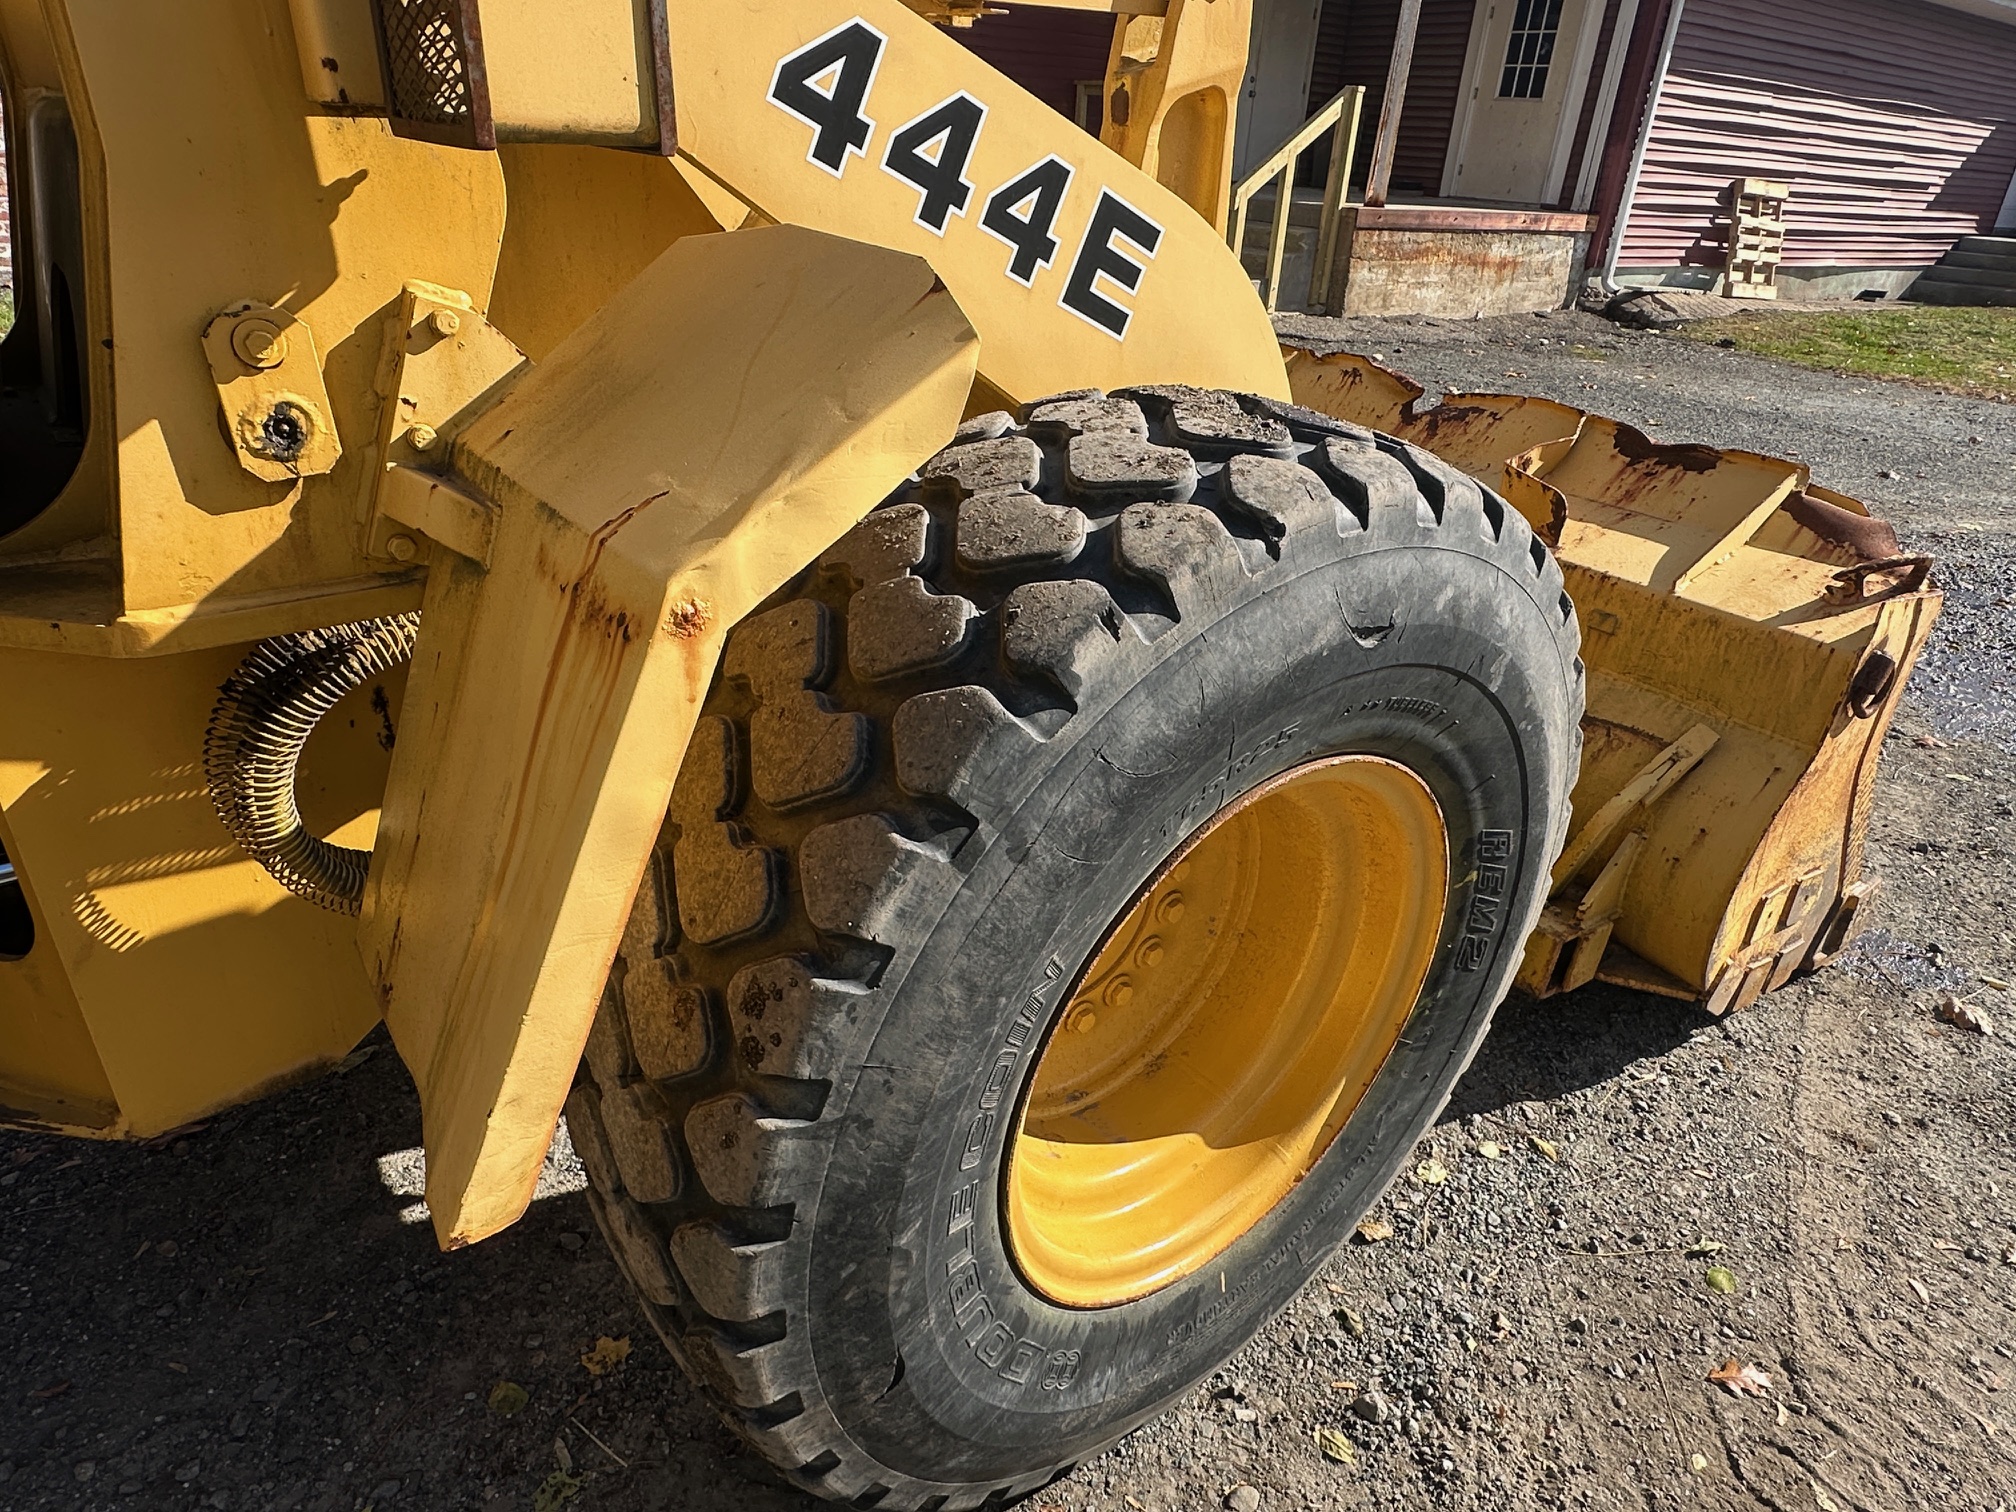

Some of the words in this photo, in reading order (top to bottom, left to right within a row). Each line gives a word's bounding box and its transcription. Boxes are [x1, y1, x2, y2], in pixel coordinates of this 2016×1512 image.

[766, 16, 1165, 341] 444E
[1454, 829, 1513, 973] REM2
[960, 957, 1063, 1171] COIN
[946, 1180, 1045, 1385] DOUBLE
